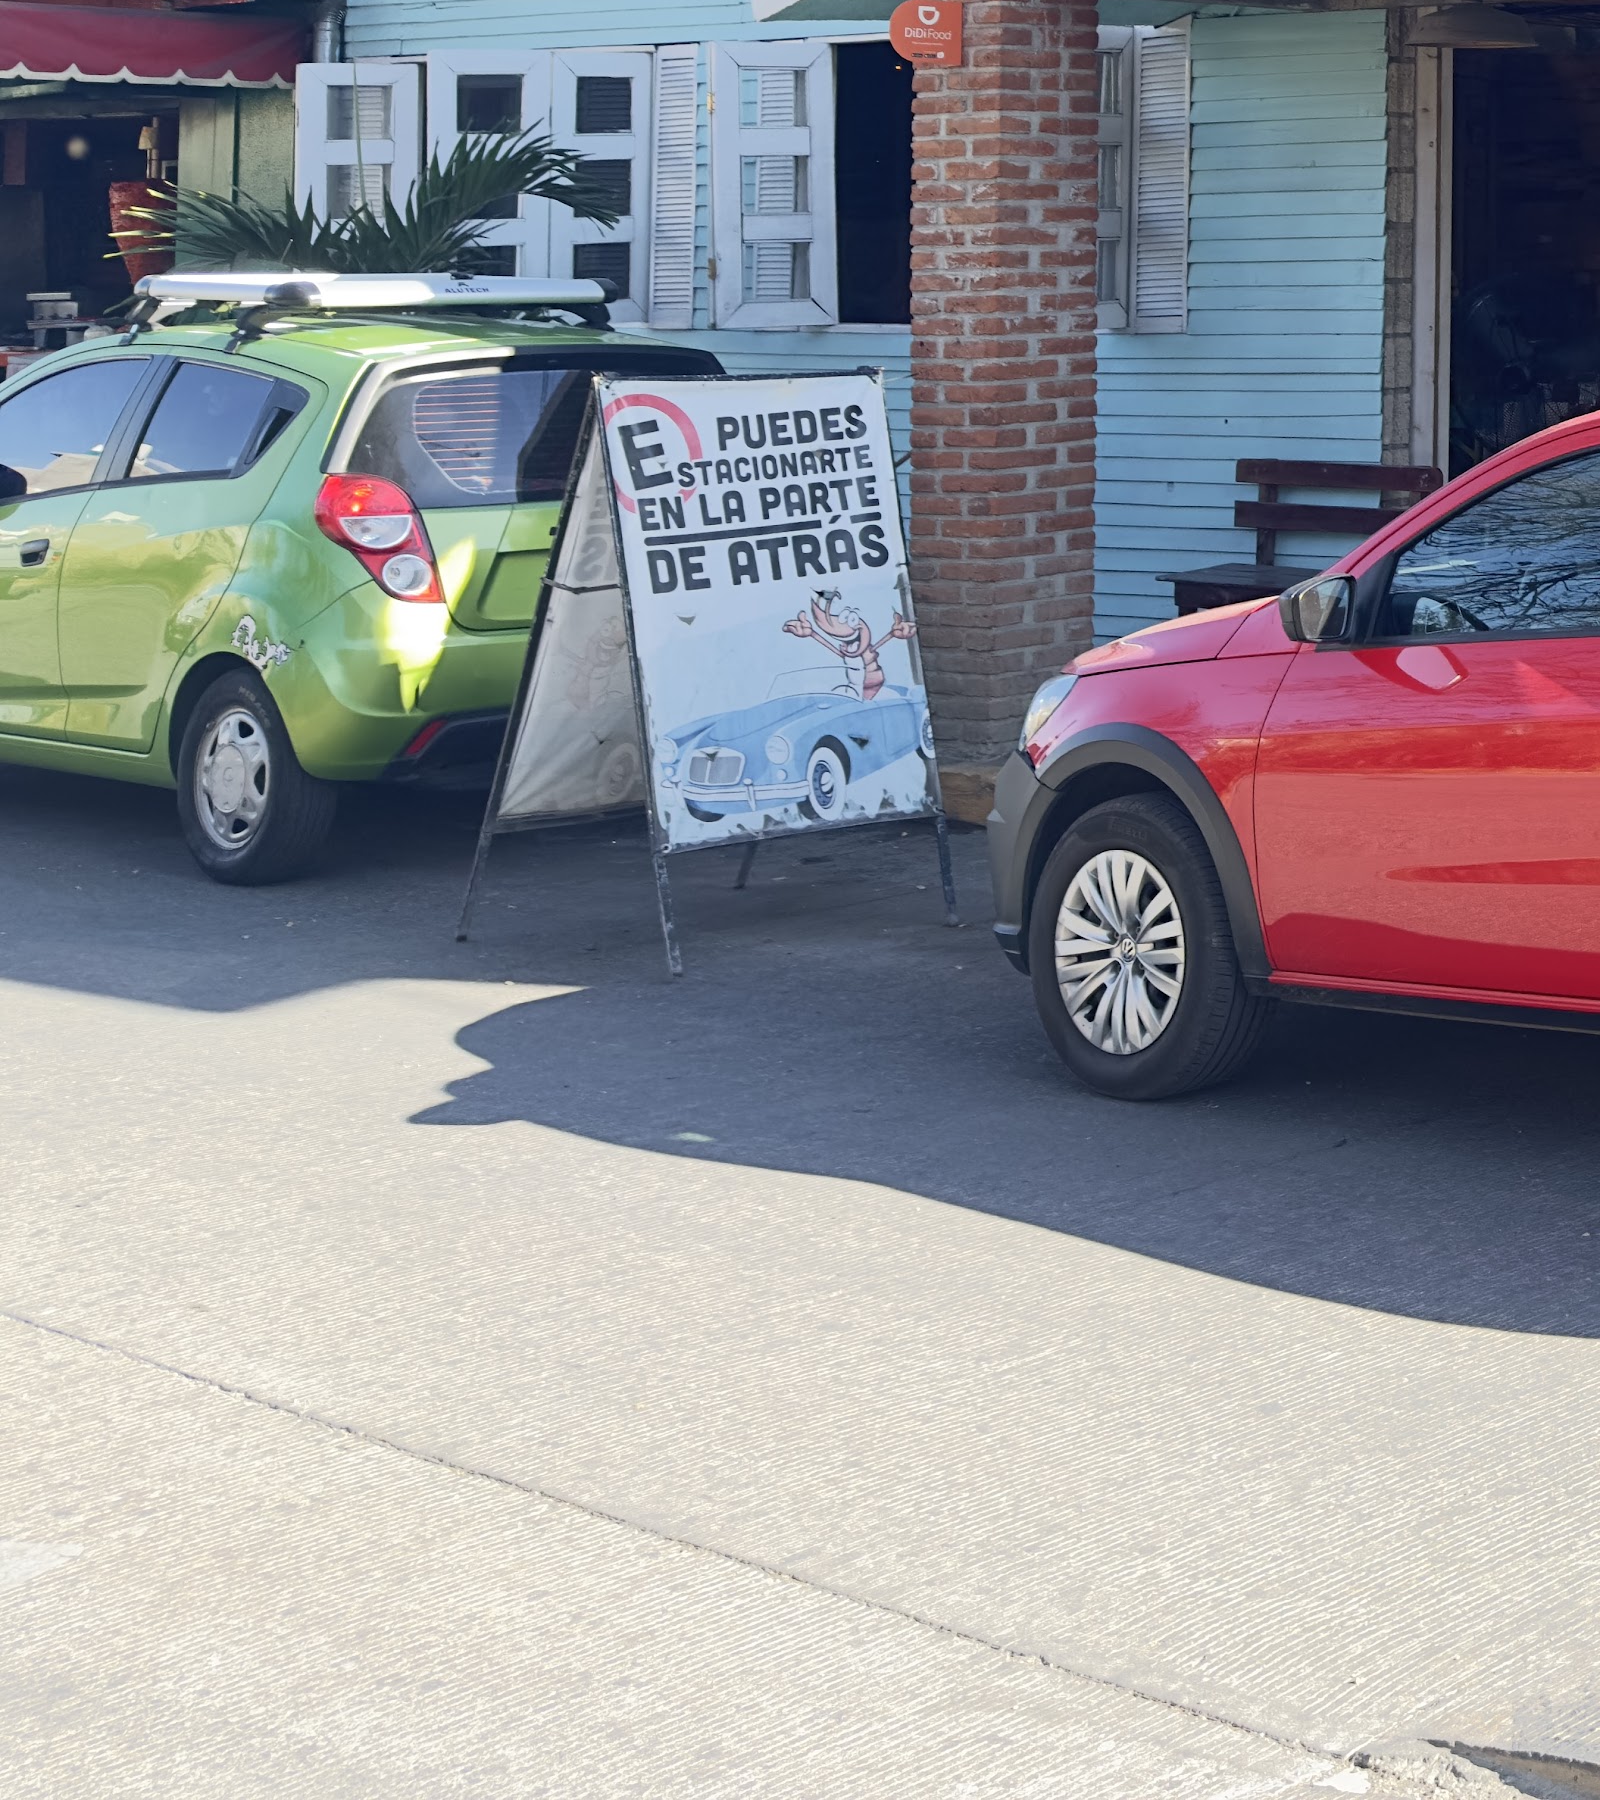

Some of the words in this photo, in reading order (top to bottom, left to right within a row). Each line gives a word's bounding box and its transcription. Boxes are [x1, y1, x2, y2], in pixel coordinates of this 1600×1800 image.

[904, 26, 927, 39] DiDi
[927, 28, 952, 41] Food
[716, 404, 867, 451] PUEDES
[637, 496, 686, 532] EN
[698, 490, 746, 526] LA
[758, 474, 880, 520] PARTE
[646, 545, 711, 595] DE
[727, 514, 889, 586] ATRÁS
